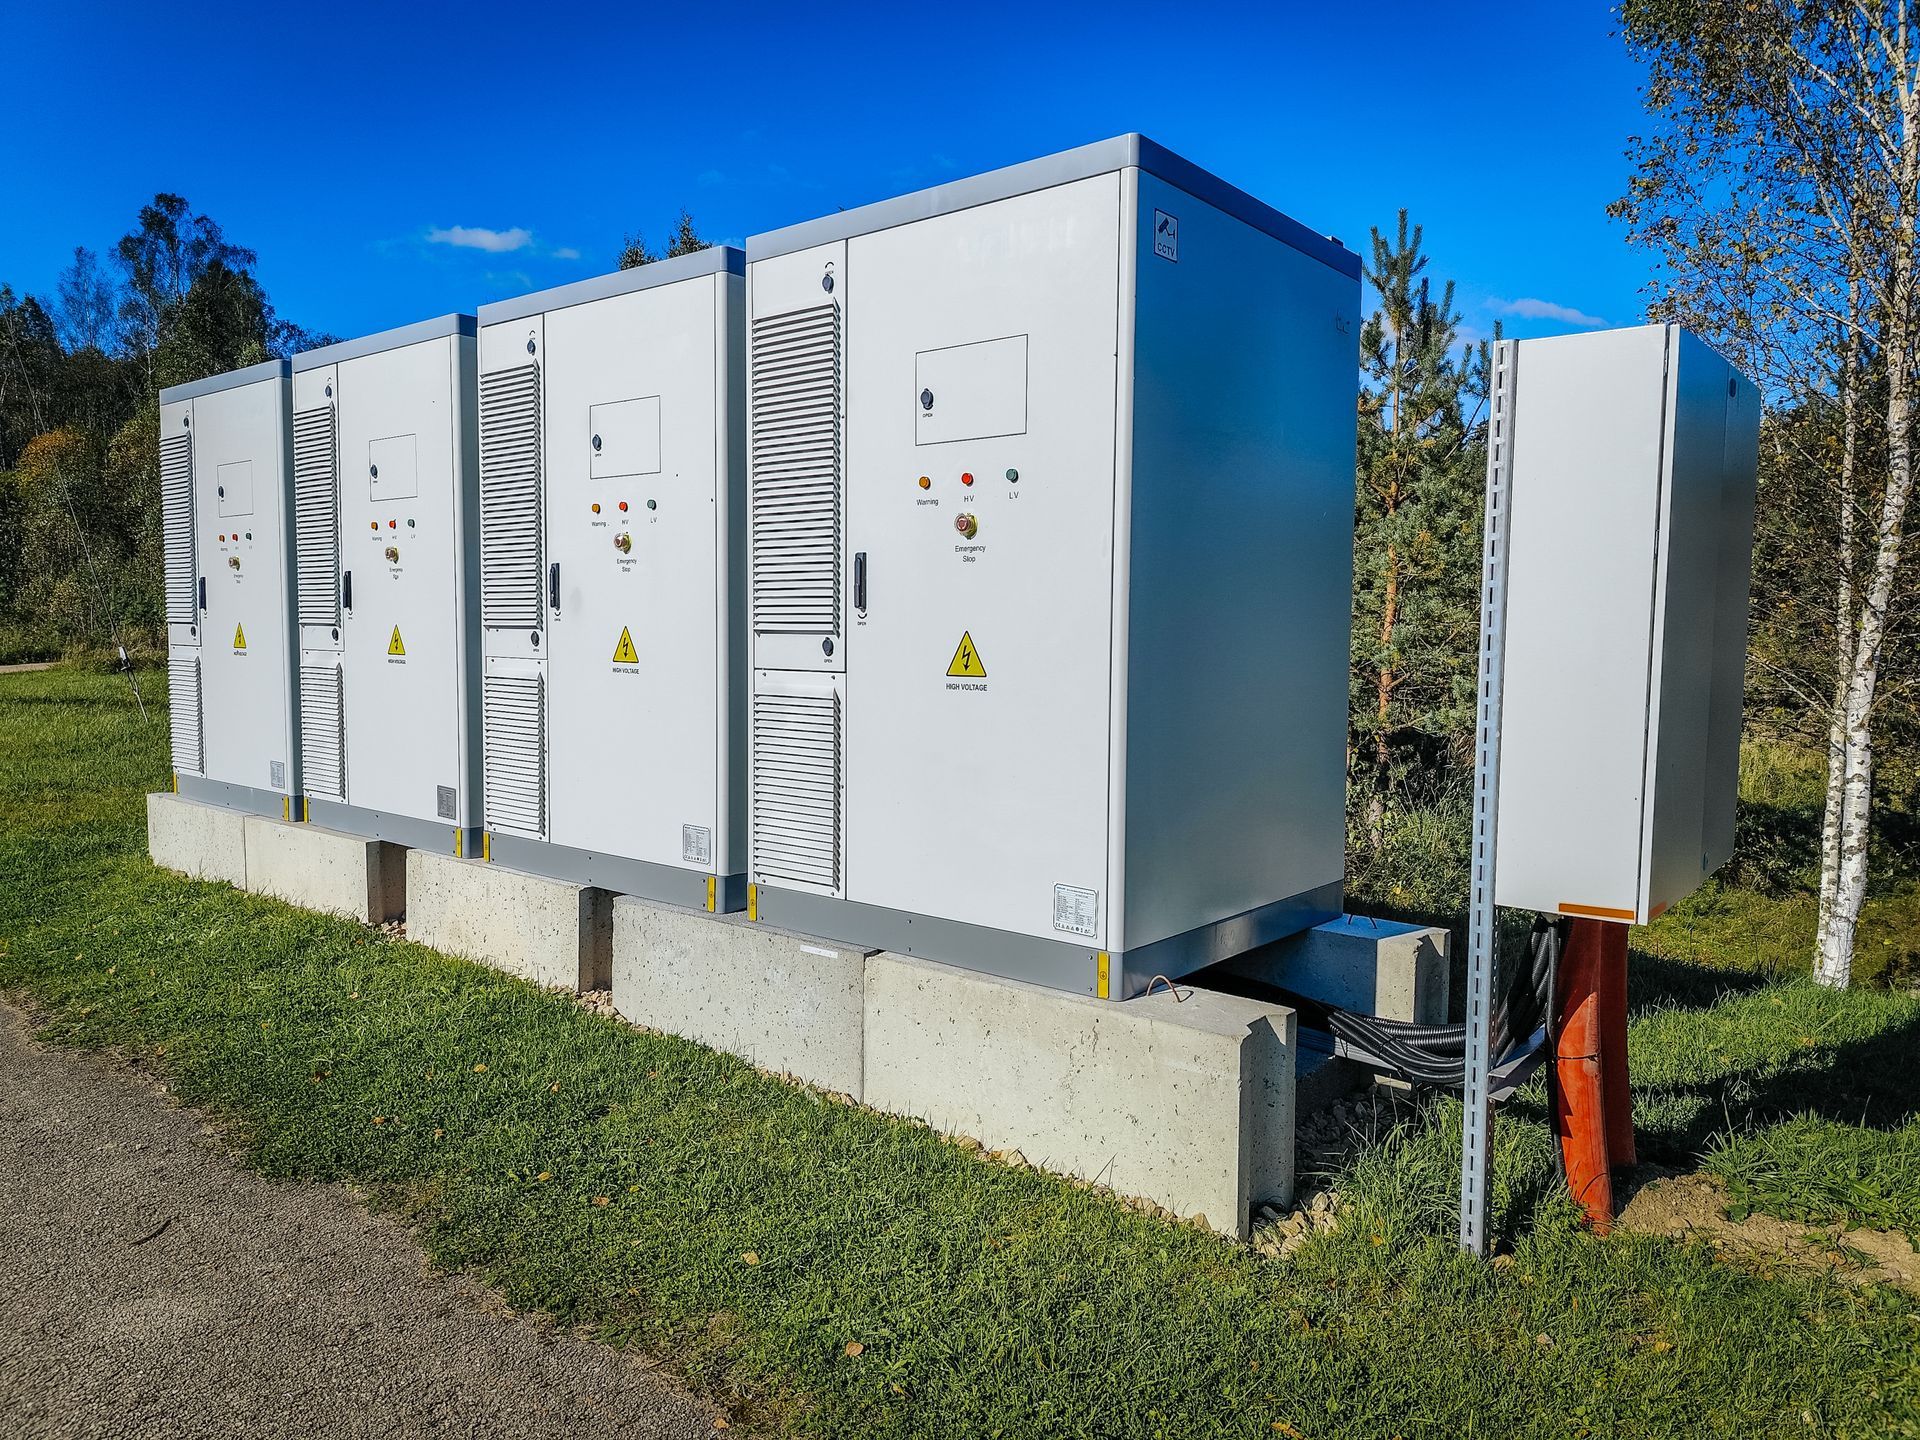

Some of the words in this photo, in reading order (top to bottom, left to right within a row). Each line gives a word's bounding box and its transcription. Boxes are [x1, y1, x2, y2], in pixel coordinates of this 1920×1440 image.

[1157, 242, 1175, 257] CCTV
[916, 498, 939, 506] Warning
[954, 545, 987, 554] Emergency
[962, 555, 976, 563] Stop
[945, 683, 960, 691] HIGH
[960, 683, 988, 692] VOLTAGE
